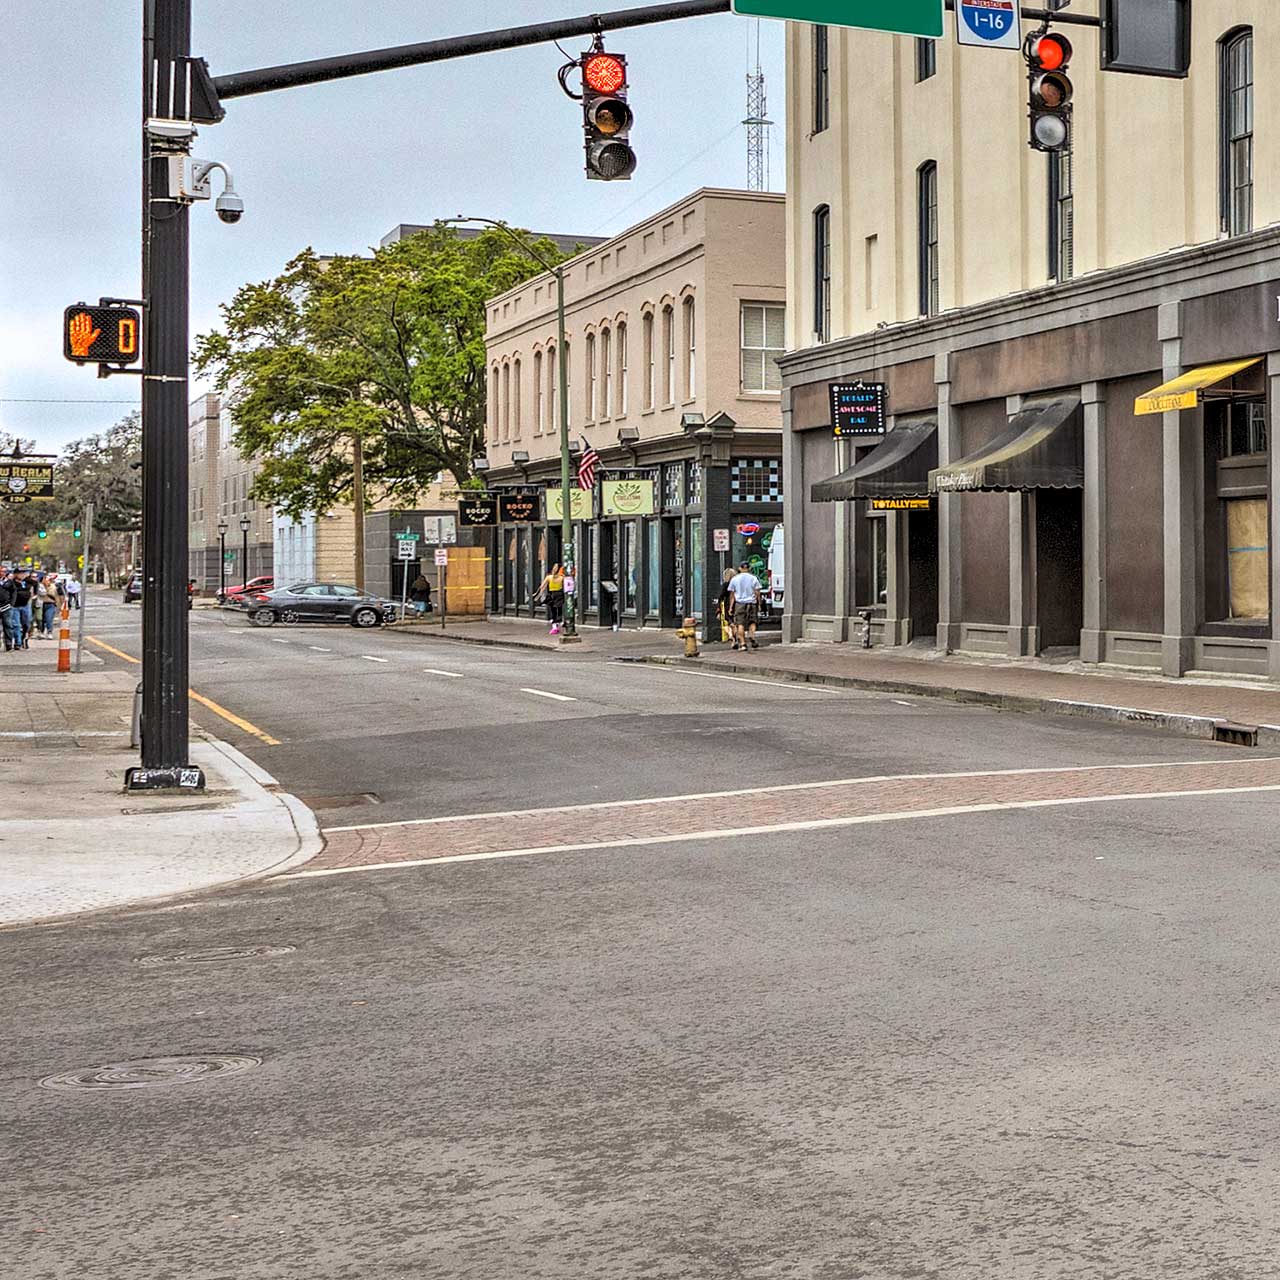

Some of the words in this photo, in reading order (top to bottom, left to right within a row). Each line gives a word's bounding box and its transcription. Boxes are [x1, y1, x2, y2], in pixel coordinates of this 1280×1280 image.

[975, 12, 1004, 29] I-16
[119, 319, 135, 353] 0
[12, 467, 51, 477] REALM
[873, 500, 910, 508] TOTALLY
